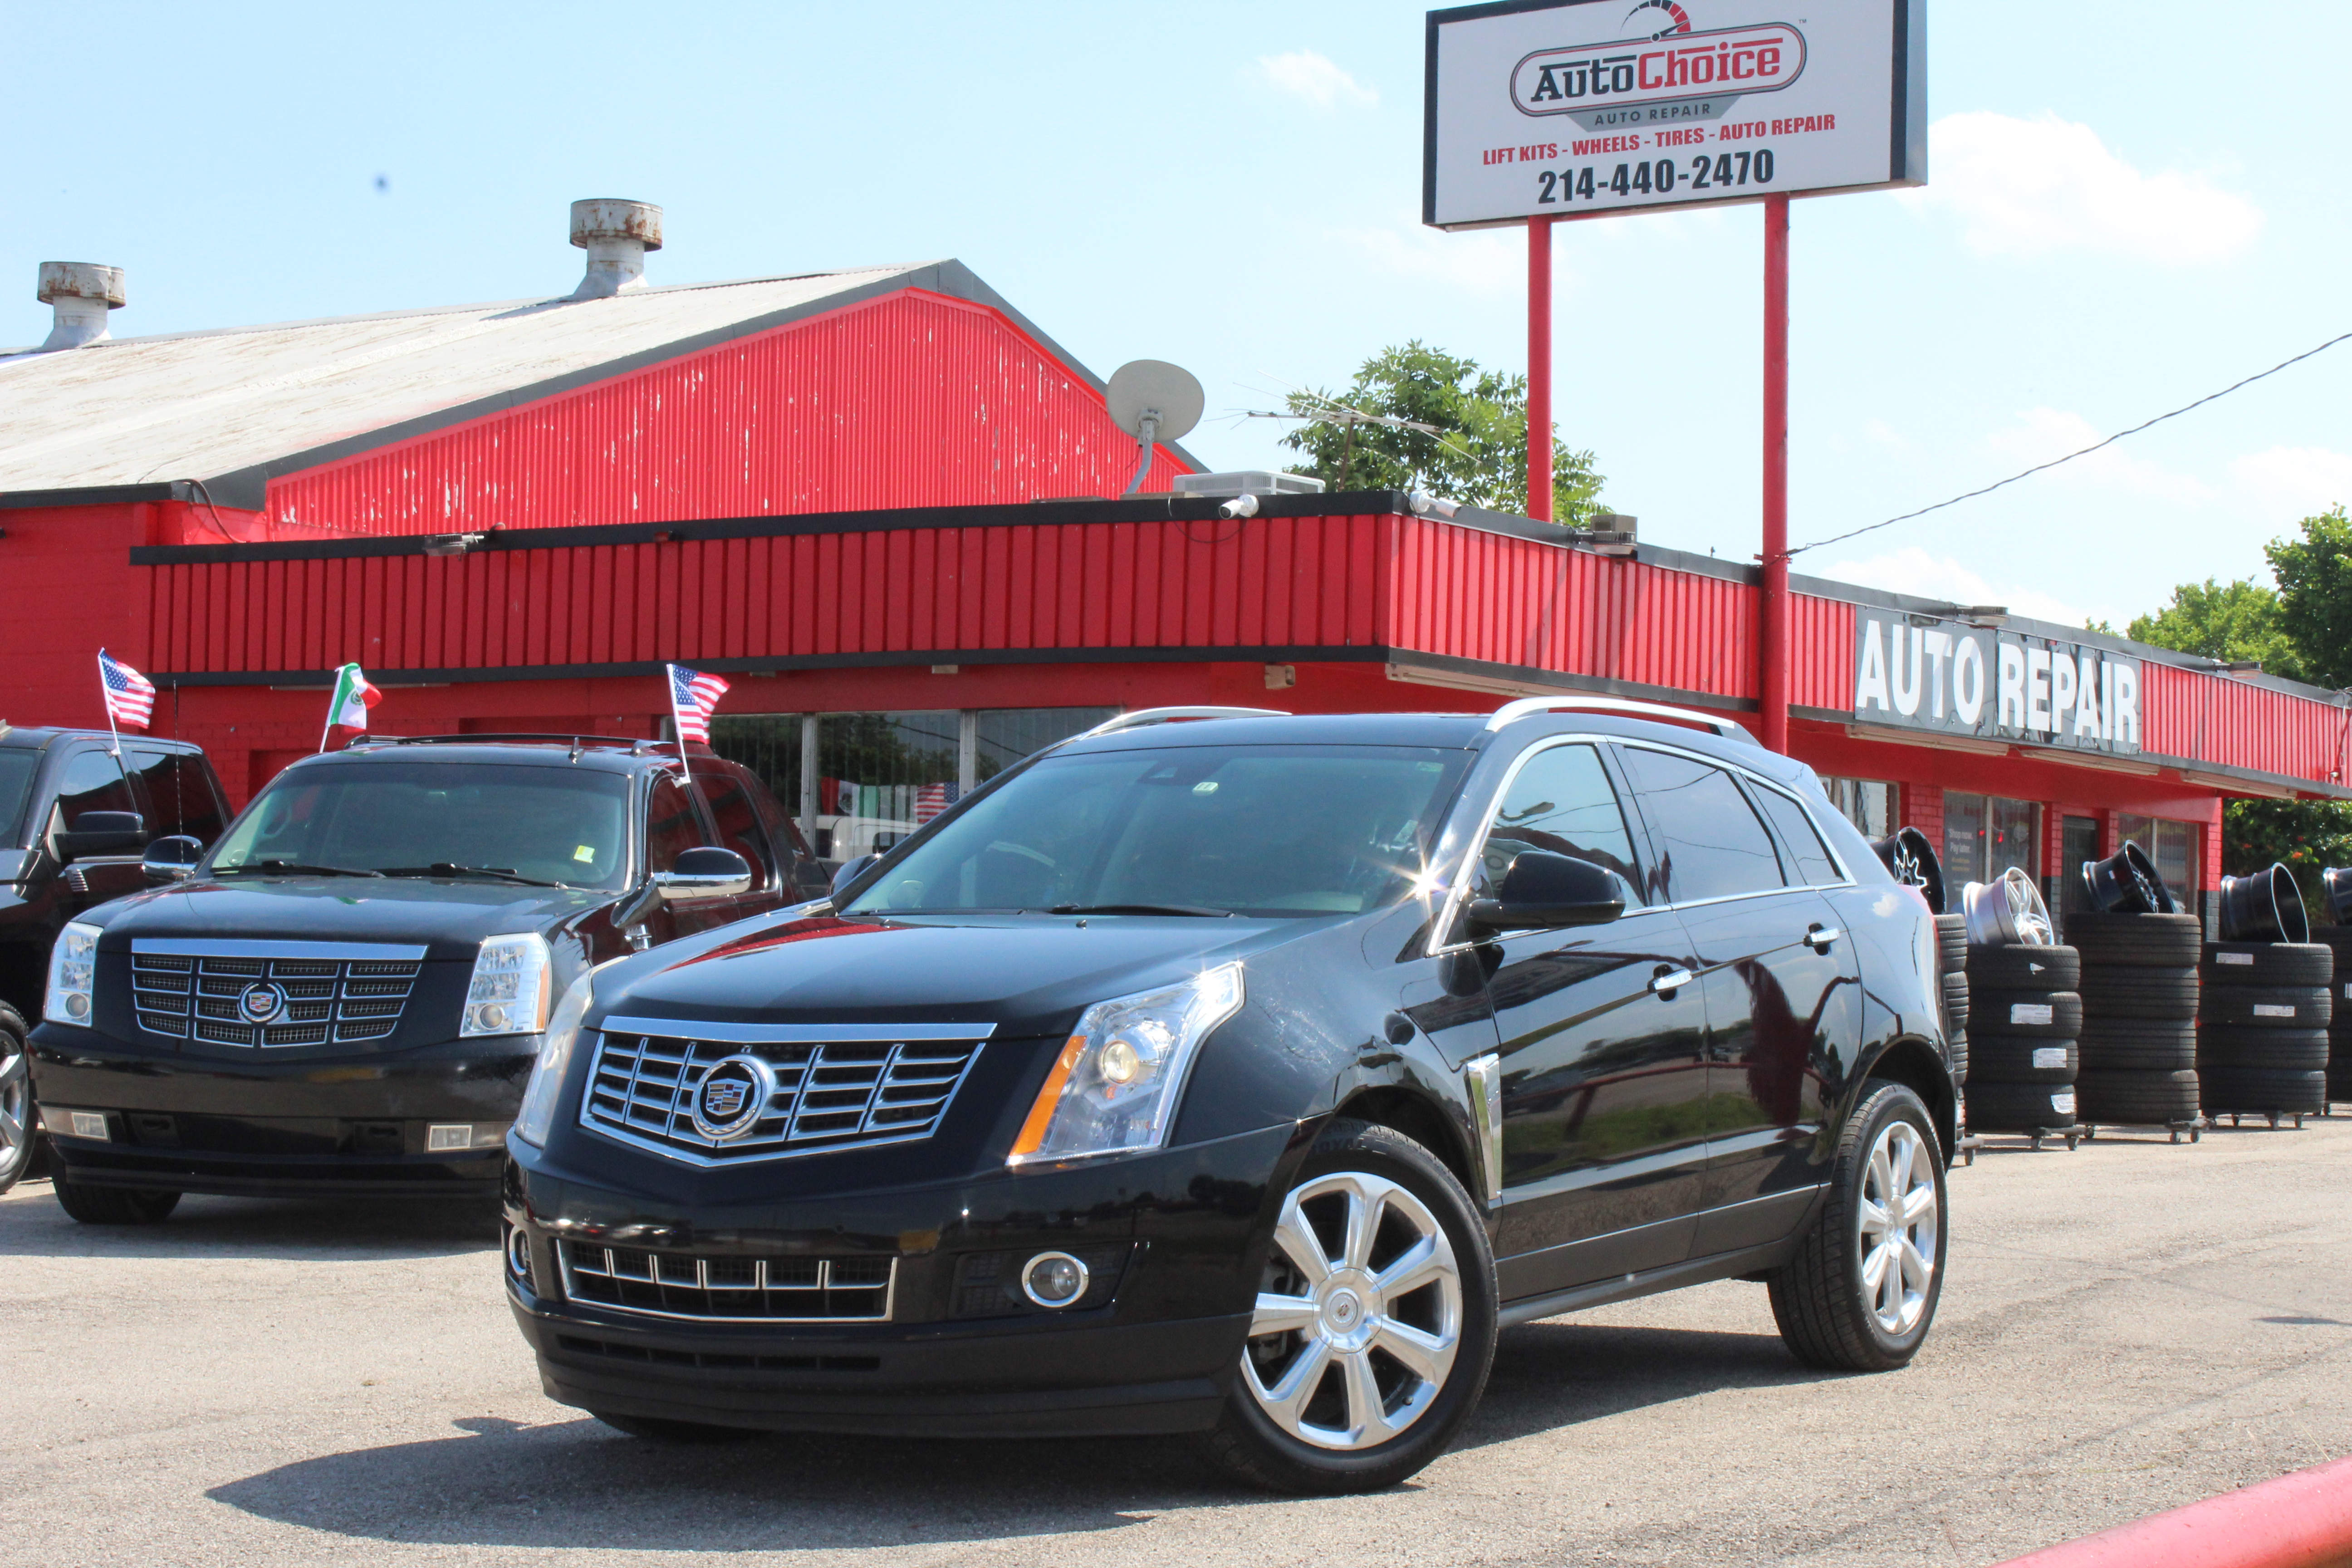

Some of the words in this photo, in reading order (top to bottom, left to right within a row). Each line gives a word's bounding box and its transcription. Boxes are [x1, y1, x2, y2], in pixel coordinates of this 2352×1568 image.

[1531, 38, 1783, 102] AutoChoice
[1483, 147, 1515, 165] LIFT
[1519, 143, 1558, 162] KITS
[1572, 135, 1640, 156] WHEELS
[1655, 127, 1704, 147] TIRES
[1719, 121, 1766, 141] AUTO
[1772, 114, 1835, 135] REPAIR
[1594, 111, 1641, 126] AUTO
[1650, 103, 1710, 120] REPAIR
[1539, 149, 1774, 204] 214-440-2470
[1856, 620, 1984, 725] AUTO
[1997, 642, 2138, 743] REPAIR
